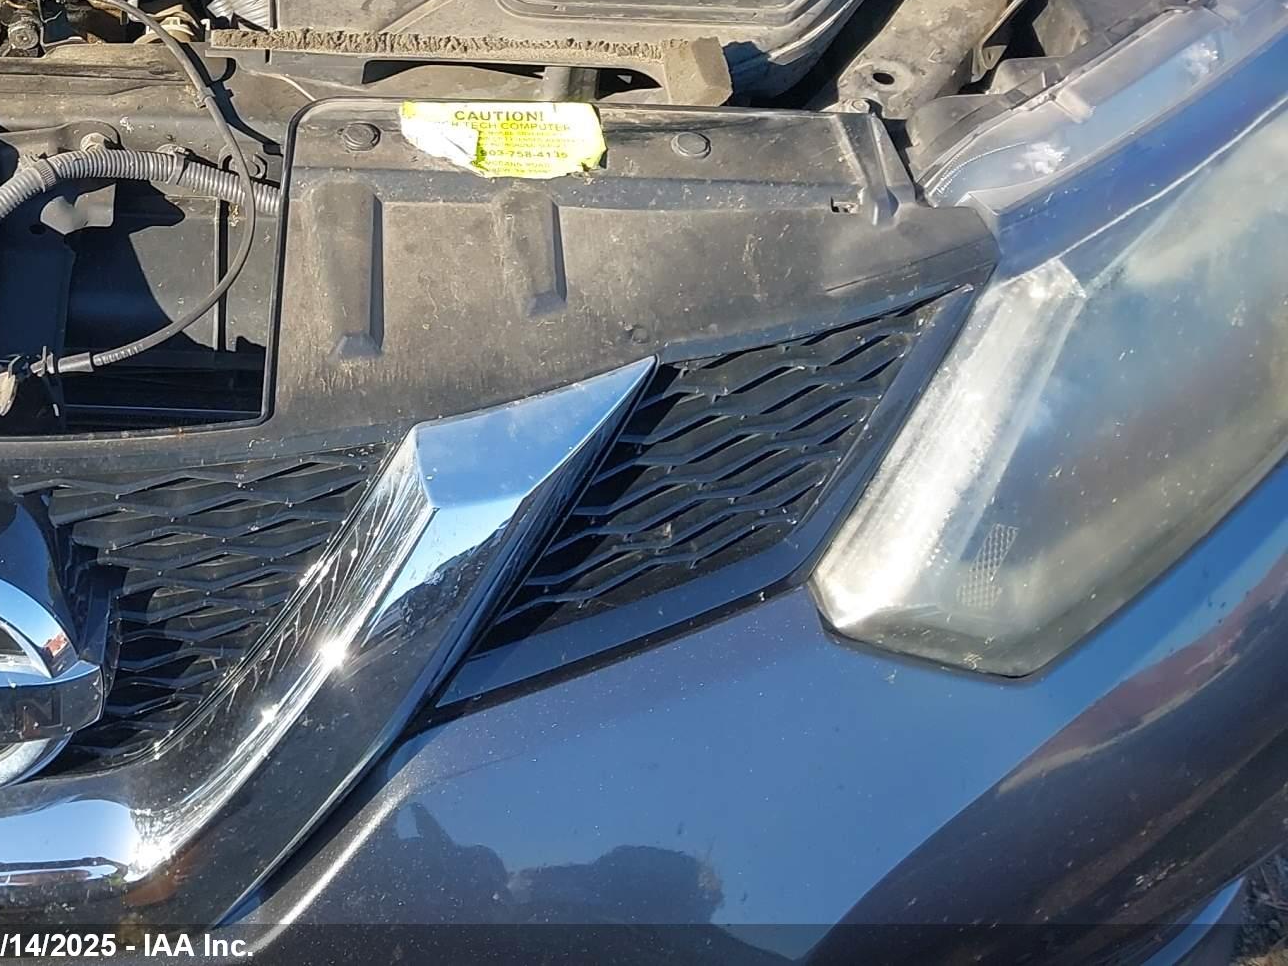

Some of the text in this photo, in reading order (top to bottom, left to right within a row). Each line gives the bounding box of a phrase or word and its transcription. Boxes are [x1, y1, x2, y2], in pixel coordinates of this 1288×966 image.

[454, 110, 544, 121] CAUTION!
[465, 121, 497, 130] TECH
[500, 122, 571, 131] COMPUTER
